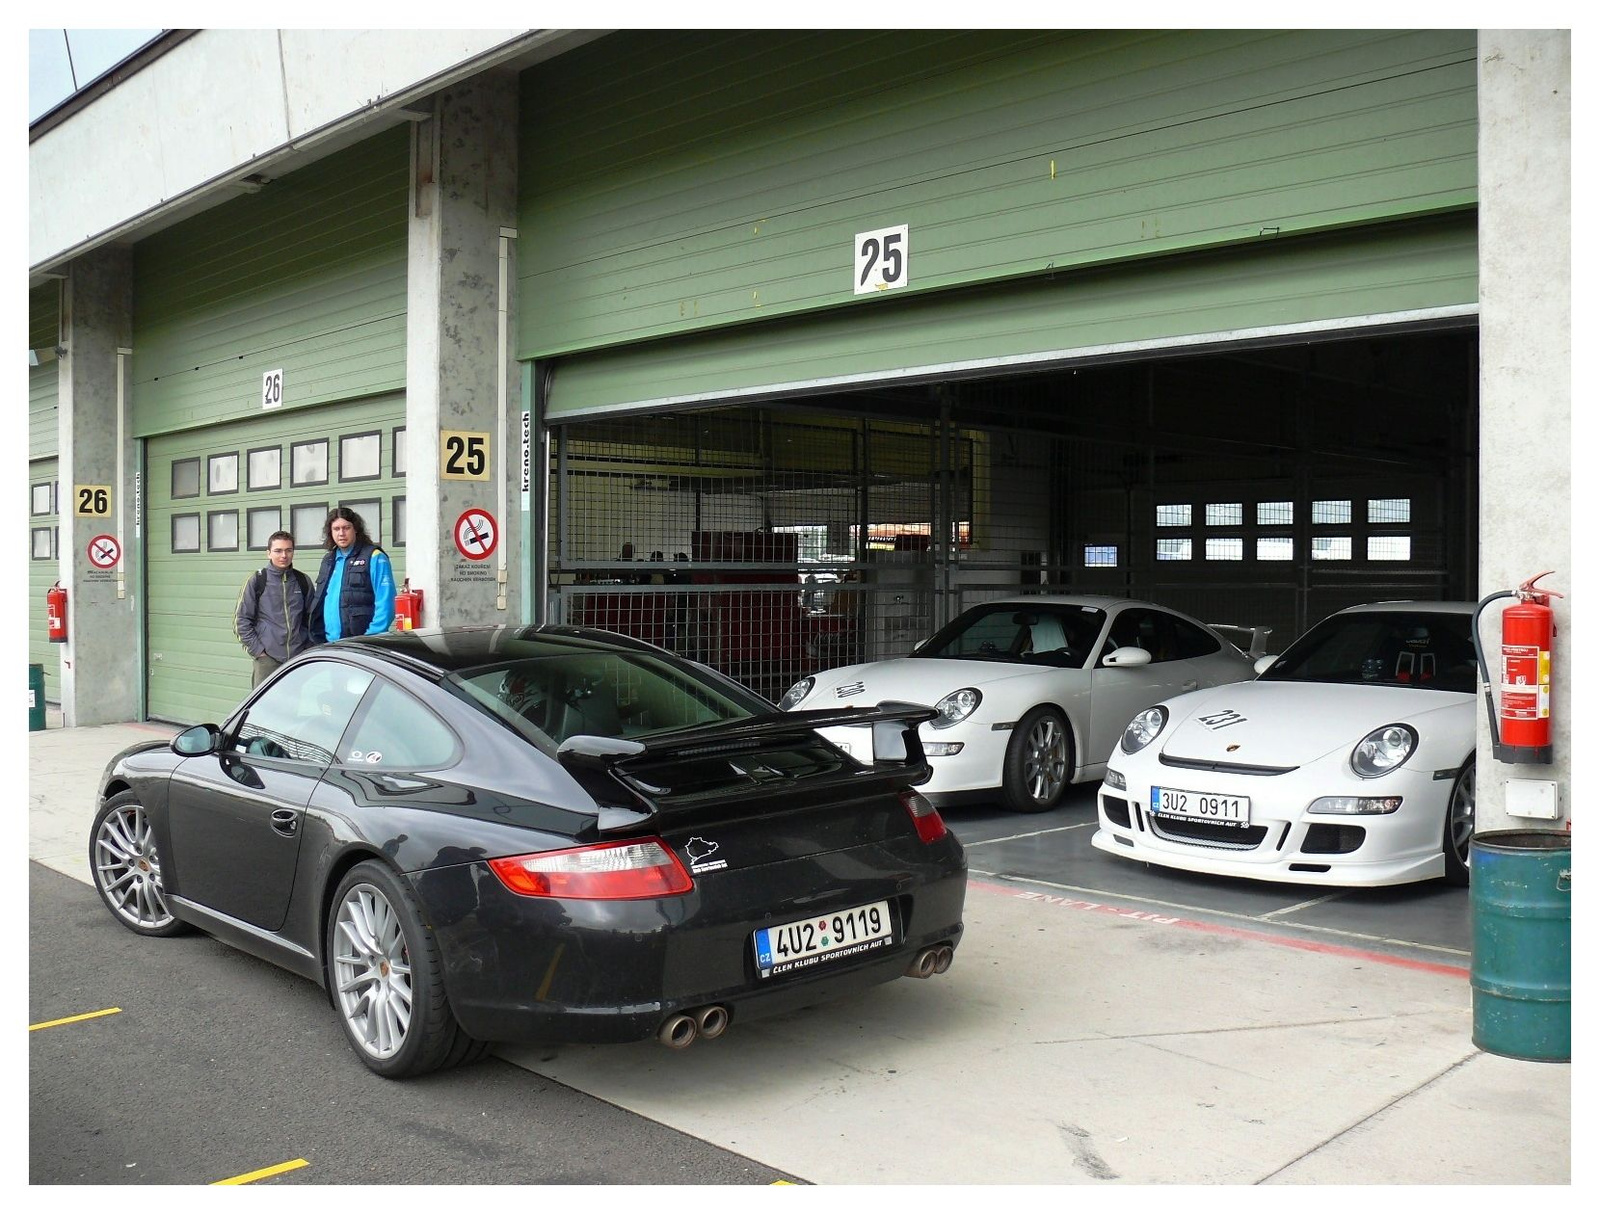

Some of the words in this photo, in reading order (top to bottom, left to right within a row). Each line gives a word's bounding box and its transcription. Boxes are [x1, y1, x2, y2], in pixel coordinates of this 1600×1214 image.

[861, 233, 902, 287] 25
[264, 373, 280, 404] 26
[445, 435, 486, 476] 25
[78, 488, 108, 514] 26
[1198, 709, 1248, 730] 231
[1162, 792, 1188, 813] 3U2
[1199, 797, 1239, 818] 0911
[776, 923, 817, 958] 4U2
[832, 907, 882, 944] 9119
[760, 953, 771, 964] CZ
[794, 957, 819, 969] KLUBU
[869, 939, 883, 950] AUT
